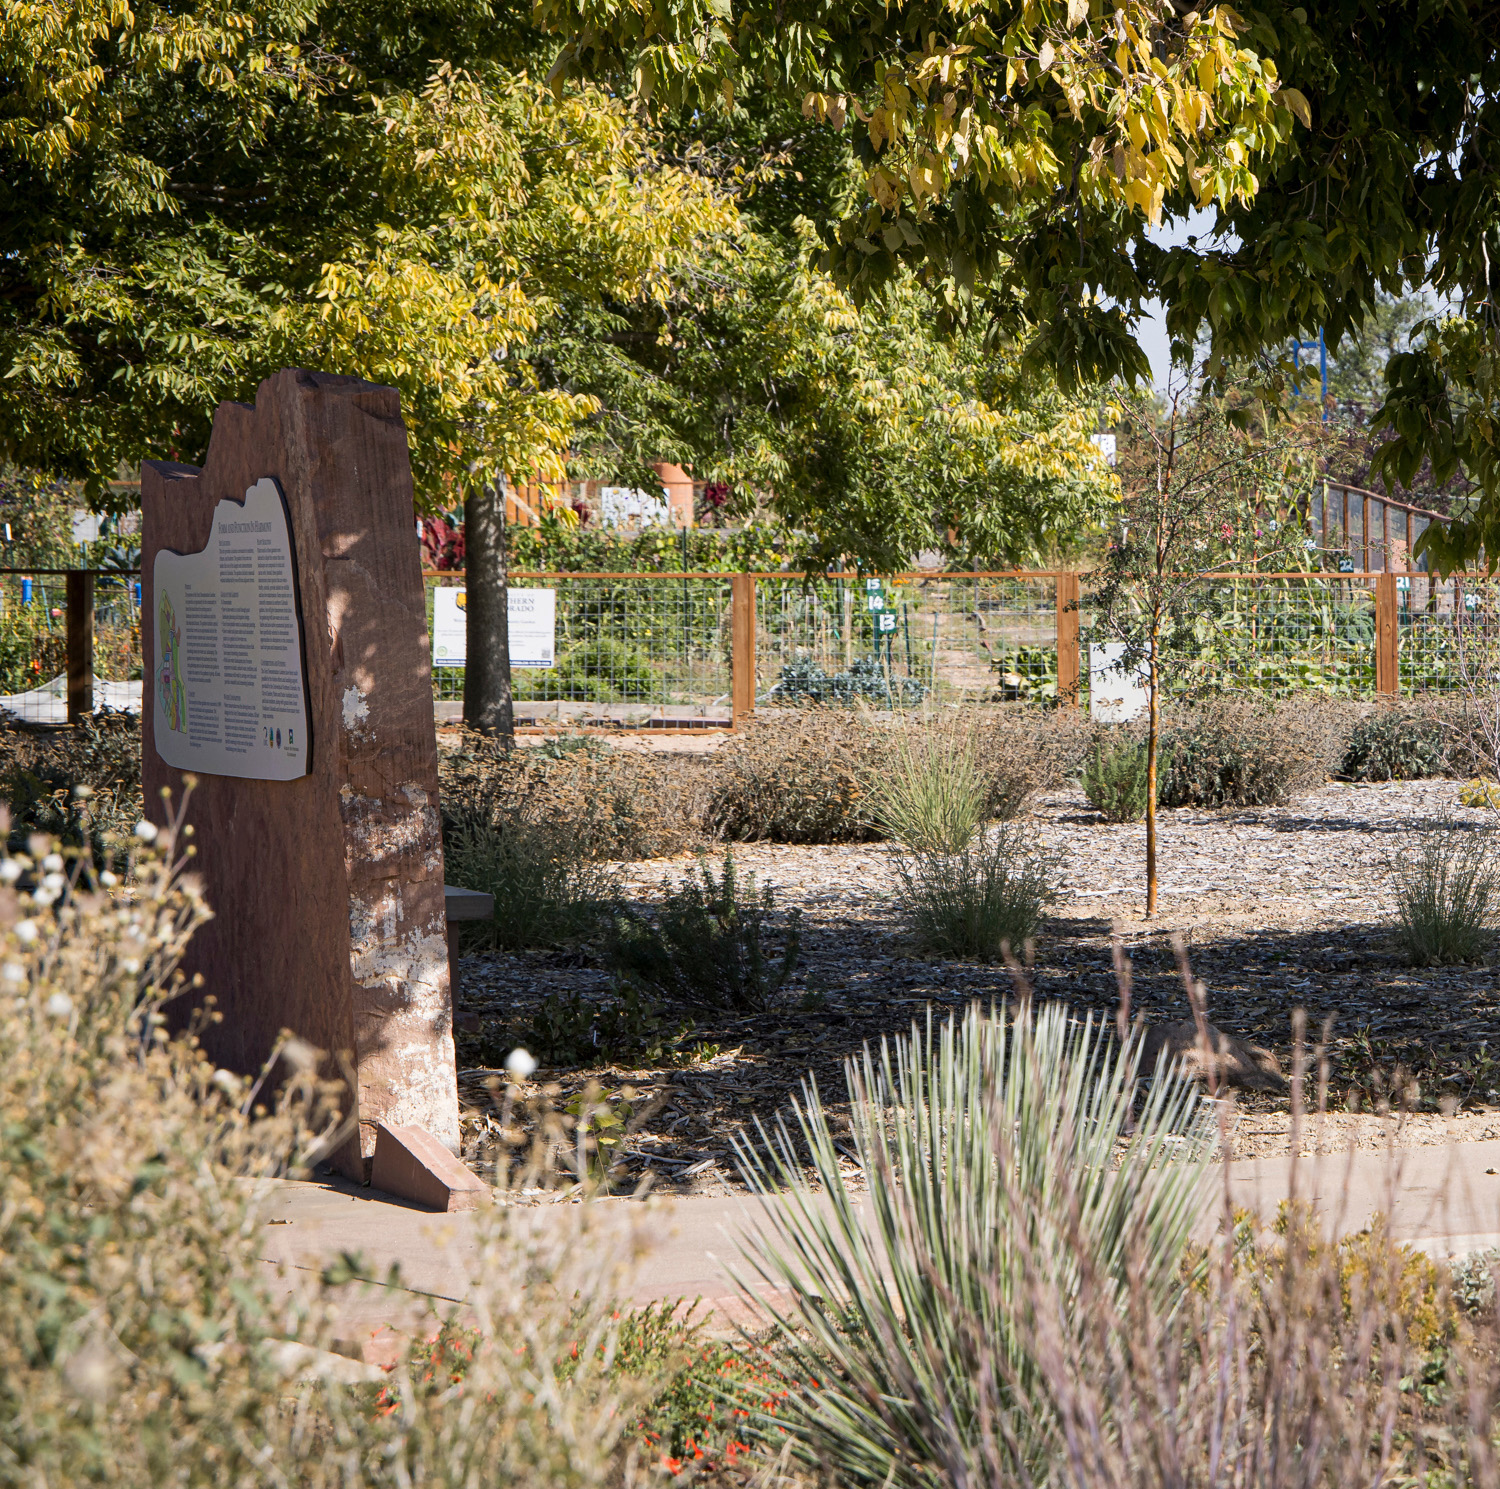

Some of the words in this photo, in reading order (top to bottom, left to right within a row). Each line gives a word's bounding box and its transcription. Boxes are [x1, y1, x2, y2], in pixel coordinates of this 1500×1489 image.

[867, 578, 880, 591] 15
[868, 595, 884, 610] 14
[879, 614, 896, 632] 13
